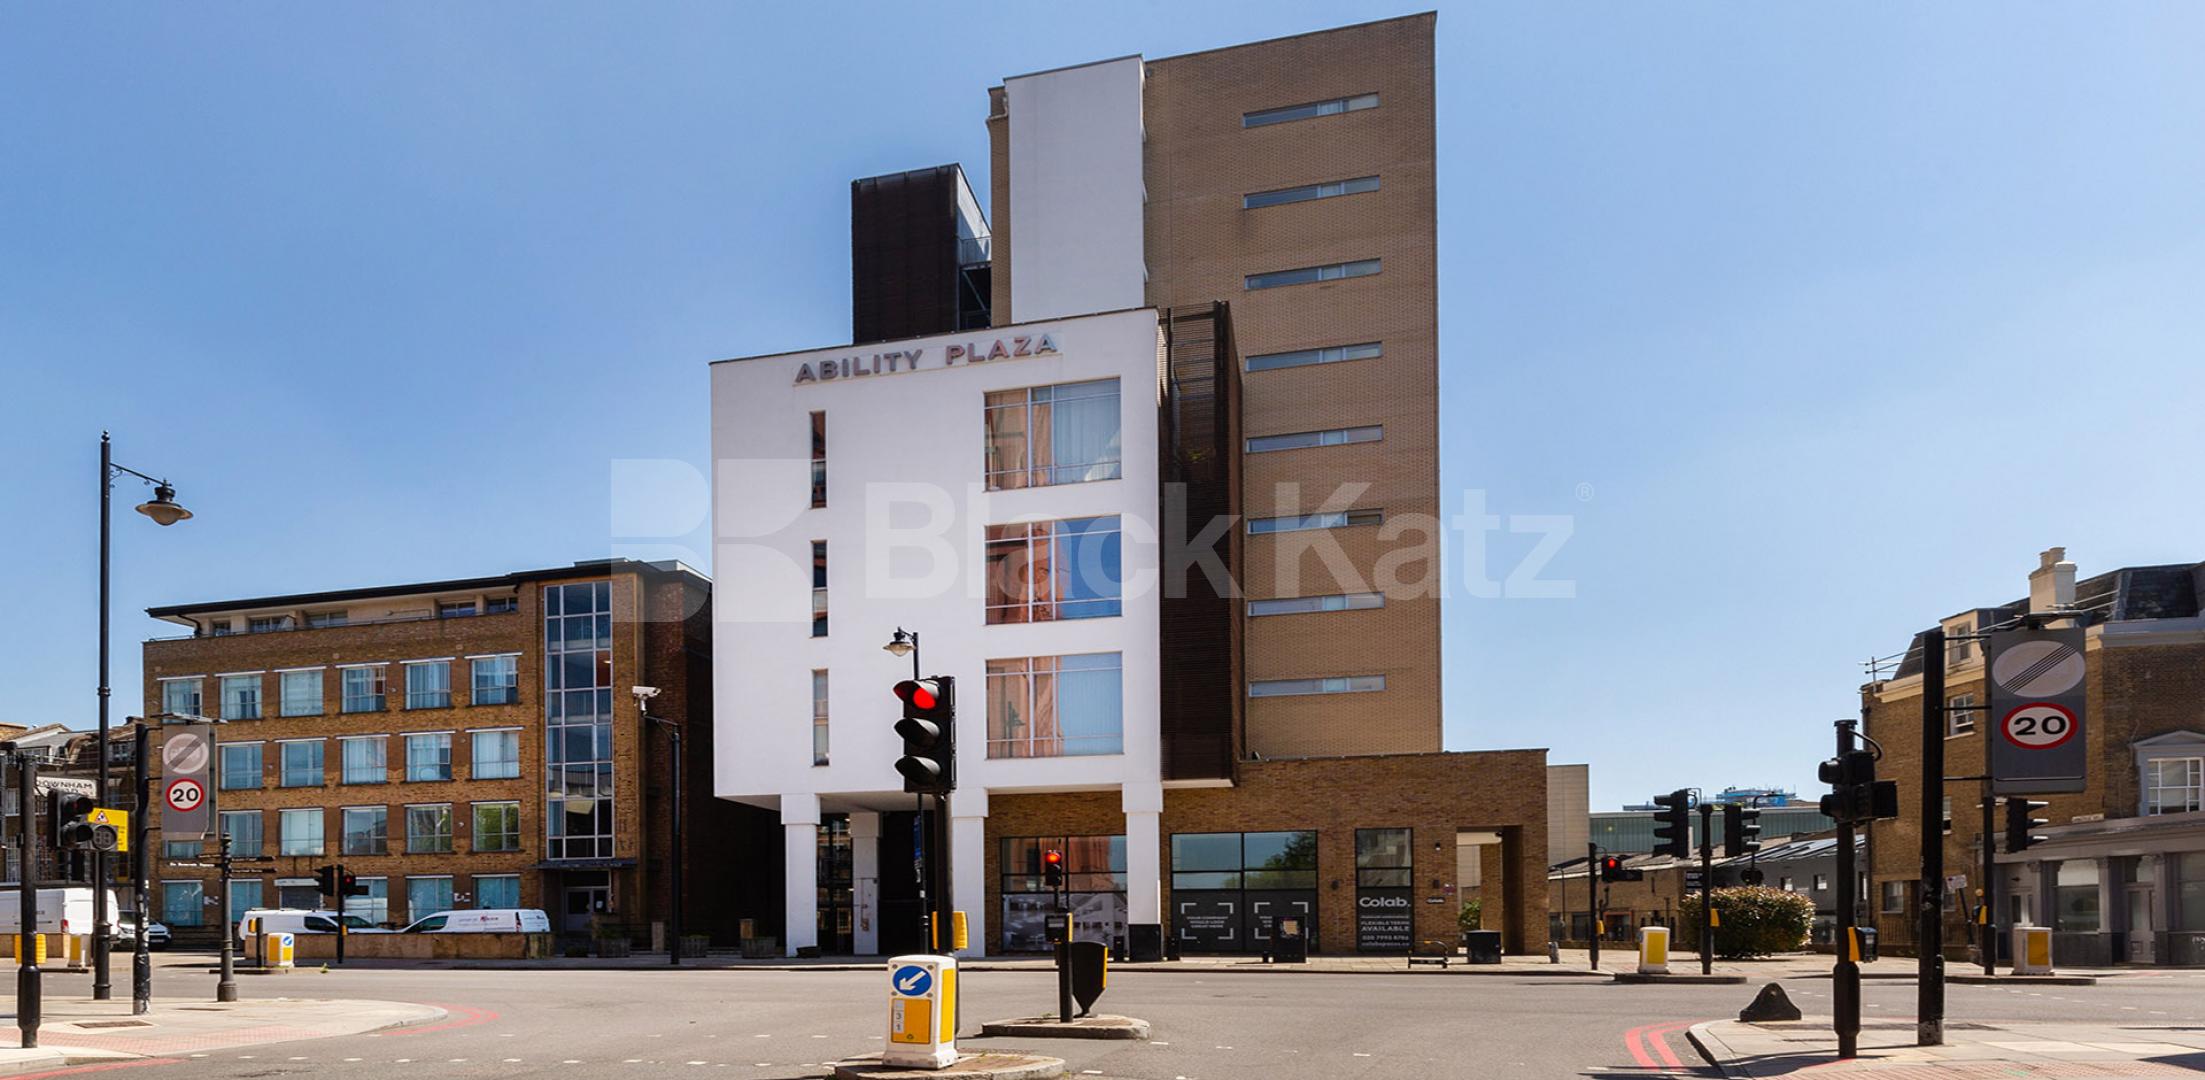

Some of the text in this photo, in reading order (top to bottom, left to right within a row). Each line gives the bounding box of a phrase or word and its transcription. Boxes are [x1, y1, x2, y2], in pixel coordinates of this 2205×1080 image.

[794, 334, 1058, 383] ABILITY PLAZA
[2014, 715, 2067, 736] 20
[172, 787, 199, 803] 20
[1359, 896, 1411, 908] Colab.
